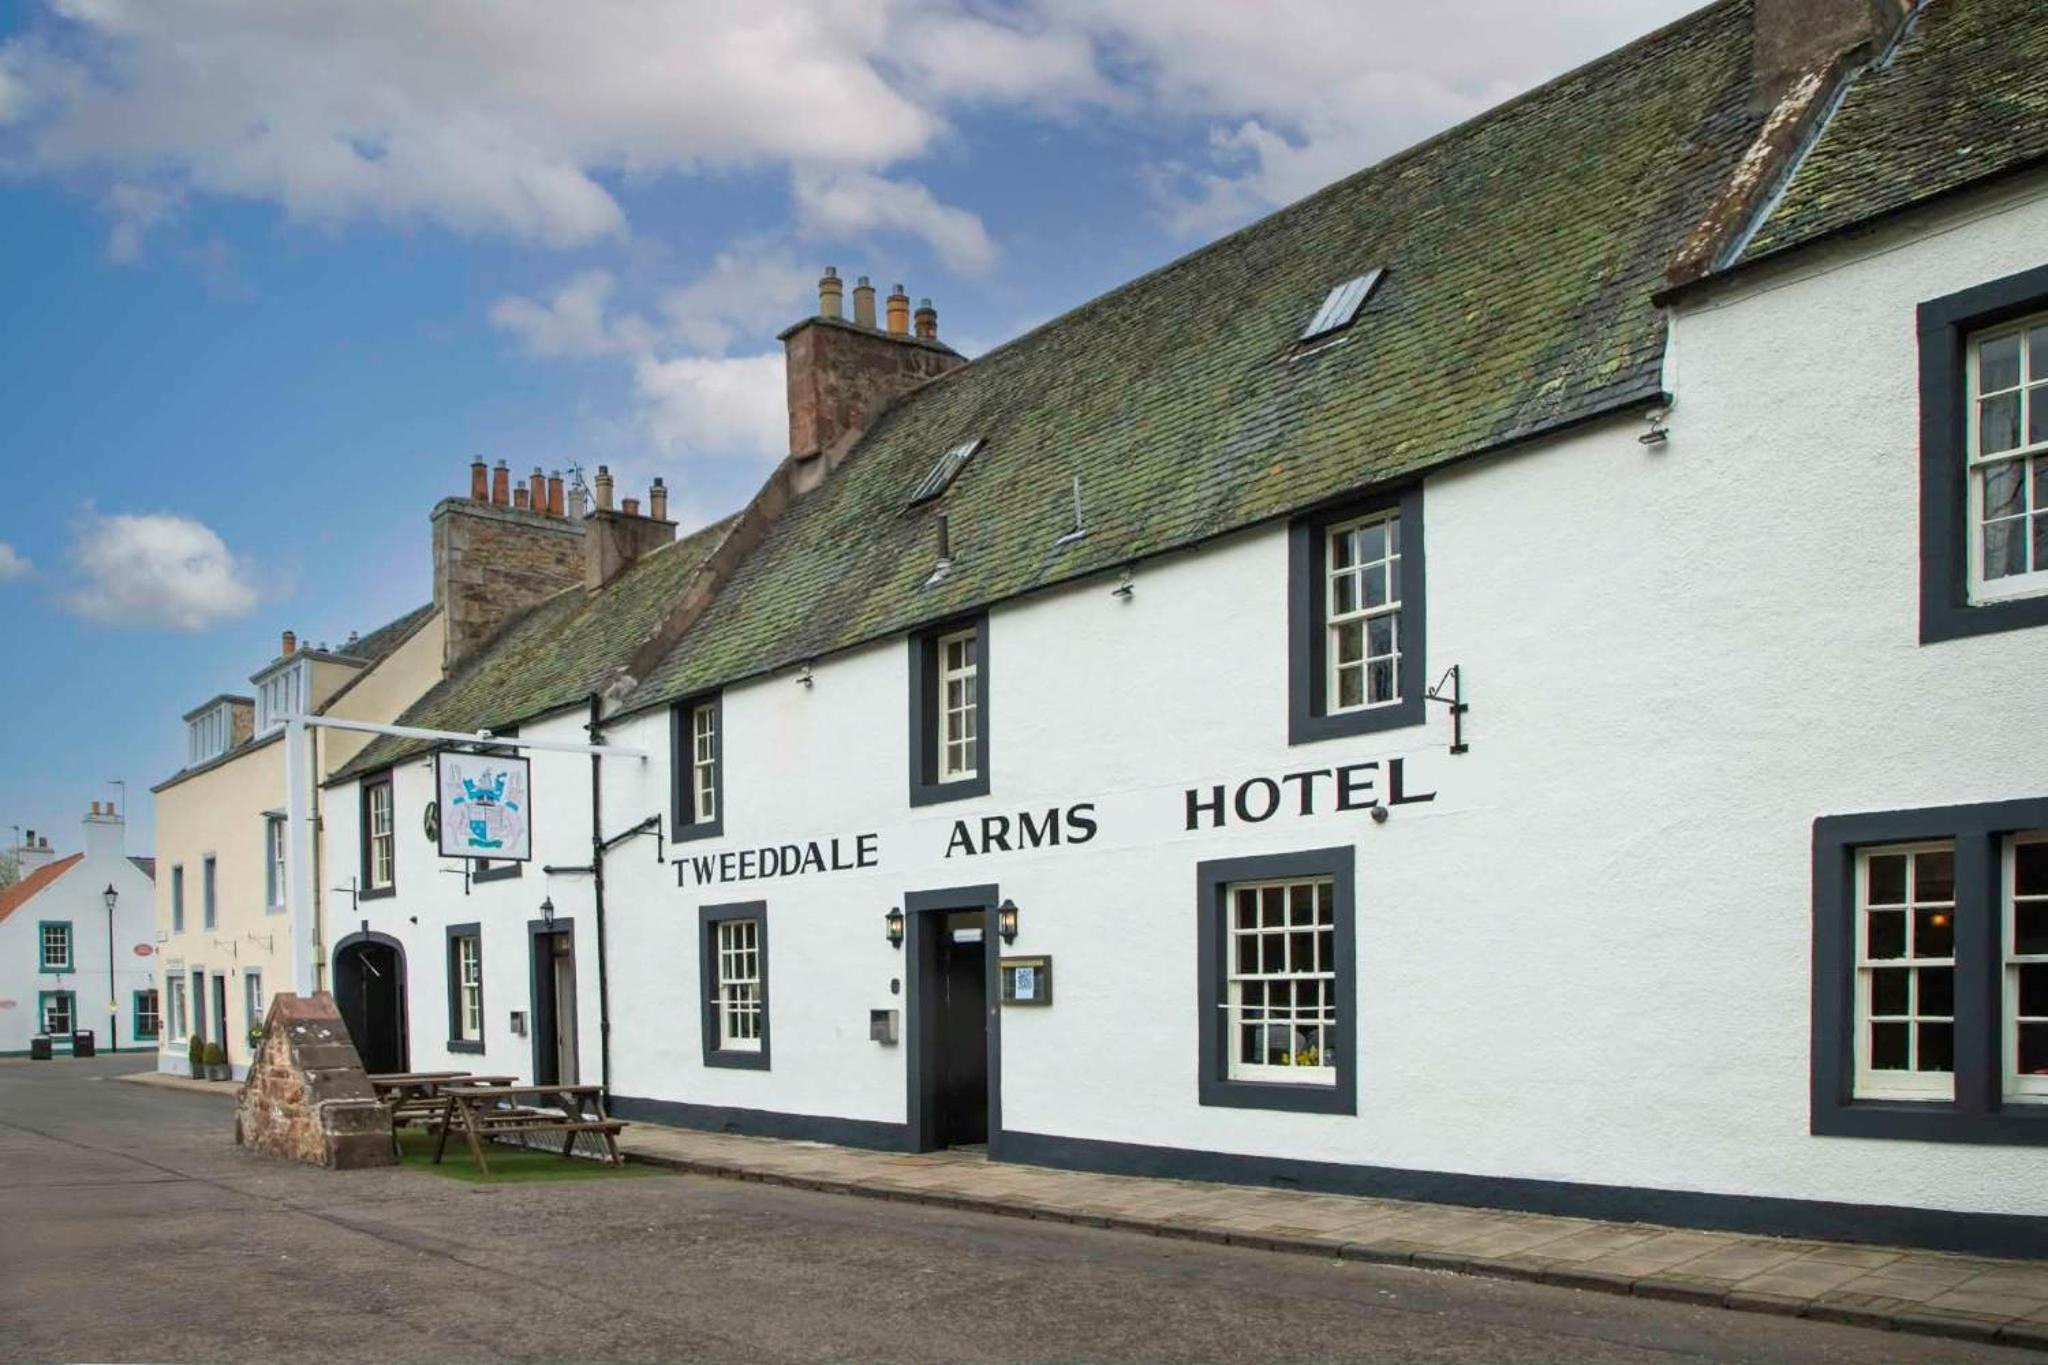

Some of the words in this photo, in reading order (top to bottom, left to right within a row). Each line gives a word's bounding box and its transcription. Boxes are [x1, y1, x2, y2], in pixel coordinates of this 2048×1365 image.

[671, 833, 878, 887] TWEEDDALE
[945, 803, 1098, 858] ARMS
[1186, 757, 1437, 831] HOTEL
